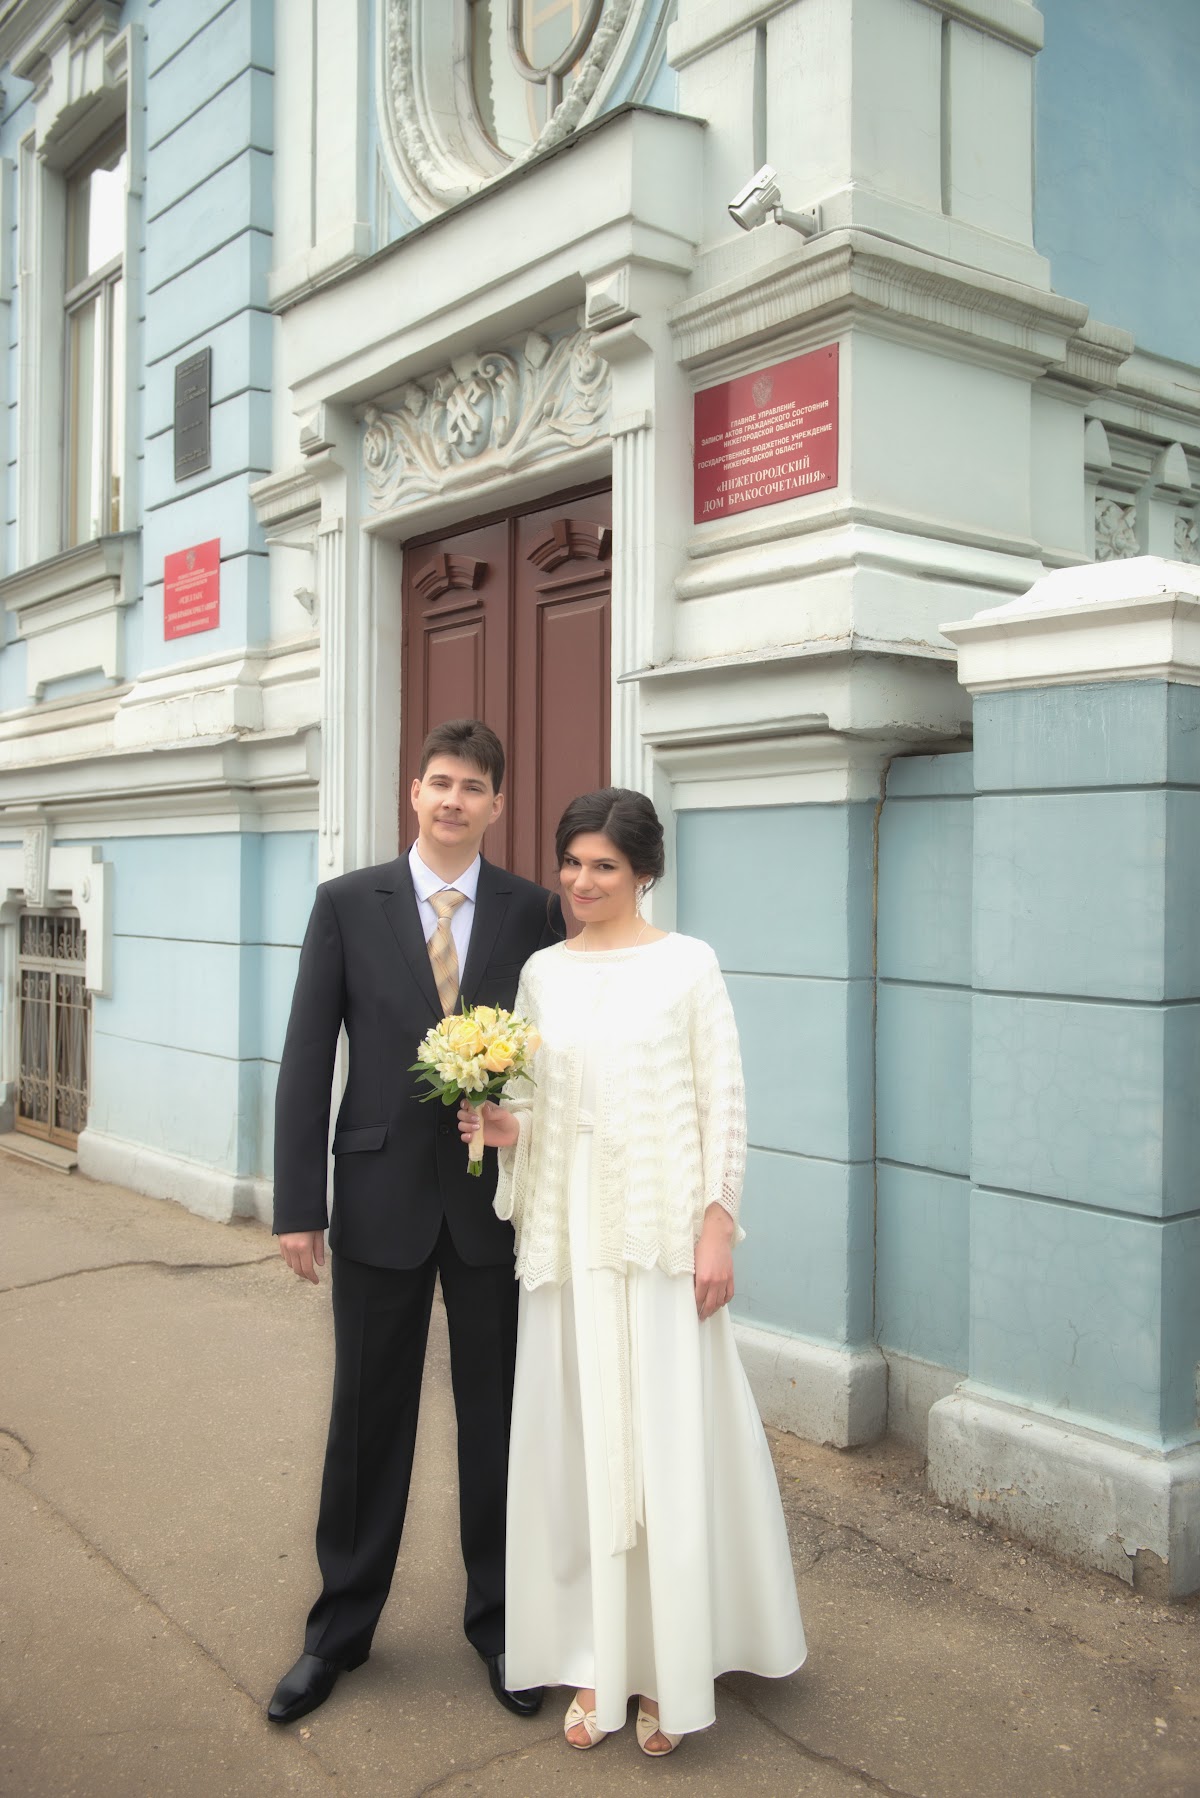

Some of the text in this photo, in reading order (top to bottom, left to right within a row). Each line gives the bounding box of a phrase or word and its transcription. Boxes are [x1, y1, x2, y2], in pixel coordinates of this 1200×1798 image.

[701, 400, 828, 446] ЗАПИСИ АКТОВ ГРАЖДАНСКОГО СОСТОЯНИЯ
[724, 418, 803, 447] НИЖЕГОРОДСКОЙ ОБЛАСТИ
[731, 401, 795, 427] ГЛАВНОЕ УПРАВЛЕНИЕ
[698, 423, 832, 469] ГОСУДАРСТВЕННОЕ БЮДЖЕТНОЕ УЧРЕЖДЕНИЕ
[724, 442, 802, 470] НИЖЕГОРОДСКОЙ ОБЛАСТИ
[703, 471, 825, 513] ДОМ БРАКОСОЧЕТАНИЯ»
[717, 455, 810, 493] «НИЖЕГОРОДСКИЙ
